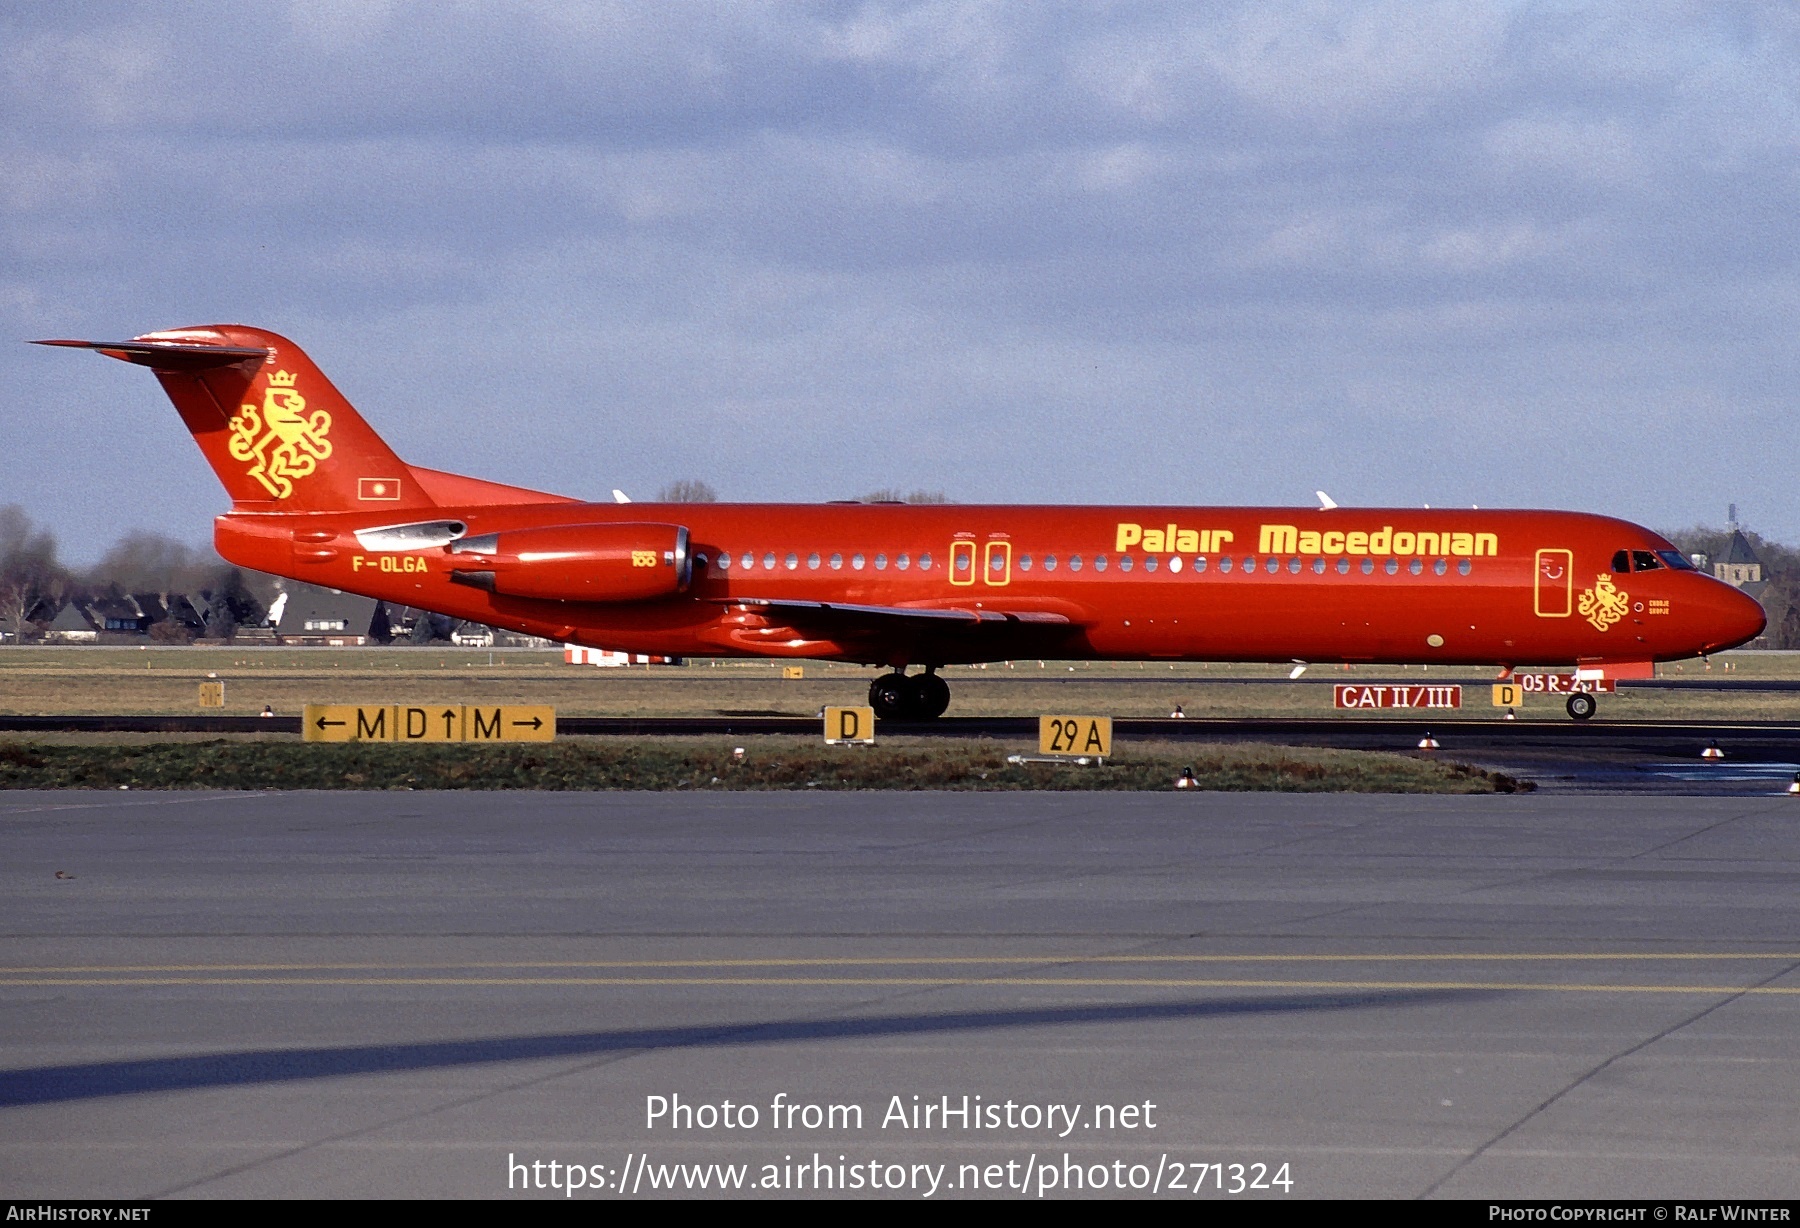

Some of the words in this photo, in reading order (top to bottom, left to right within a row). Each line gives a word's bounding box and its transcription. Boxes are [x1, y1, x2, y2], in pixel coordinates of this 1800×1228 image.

[1115, 523, 1234, 553] Palair
[1258, 525, 1498, 557] Macedonian
[352, 555, 428, 573] F-OLGA
[1342, 686, 1387, 708] CAT
[1502, 687, 1514, 705] D
[357, 708, 385, 739] M
[406, 708, 427, 739] D
[474, 708, 501, 739] M
[840, 710, 859, 739] D
[1050, 719, 1078, 751] 29
[1084, 720, 1103, 752] A
